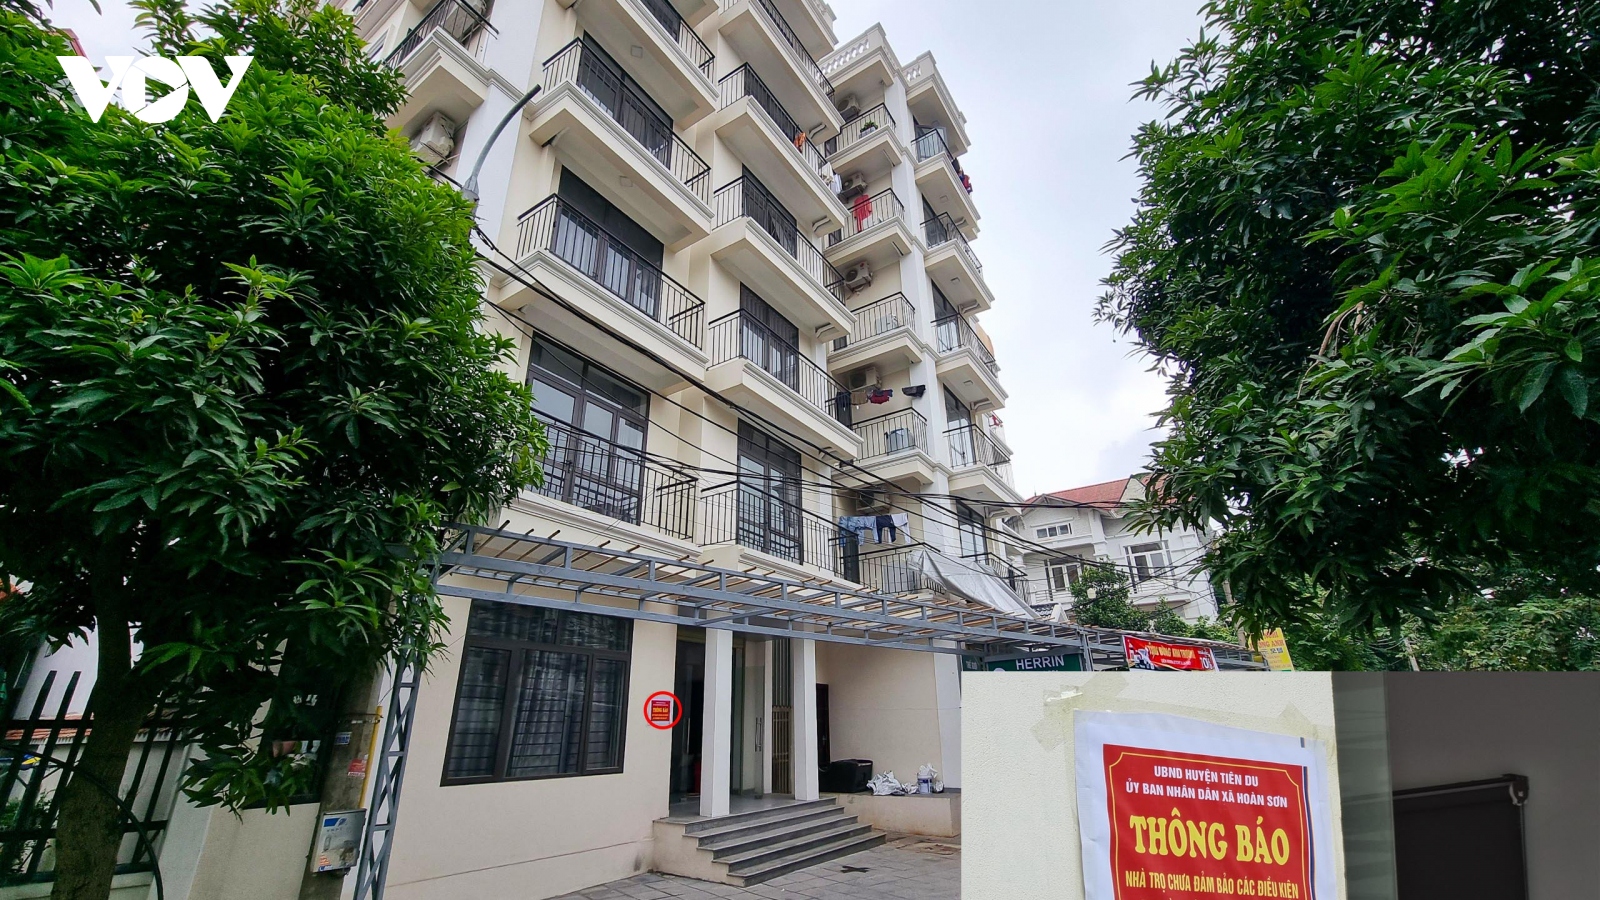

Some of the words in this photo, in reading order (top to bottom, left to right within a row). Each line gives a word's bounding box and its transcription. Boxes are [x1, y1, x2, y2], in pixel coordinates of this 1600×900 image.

[1015, 654, 1065, 670] HERRIN
[1154, 765, 1182, 779] UBND
[1185, 768, 1218, 784] HUYỆN
[1220, 772, 1242, 785] TIÊN
[1245, 775, 1259, 787] DU
[1126, 778, 1140, 793] ỦY
[1142, 784, 1164, 796] BAN
[1166, 784, 1195, 799] NHÂN
[1198, 787, 1219, 801] DÂN
[1221, 789, 1235, 803] XÃ
[1237, 791, 1265, 806] HOÀN
[1267, 795, 1288, 808] SƠN
[1129, 807, 1228, 861] THÔNG
[1235, 815, 1290, 866] BÁO
[1125, 868, 1146, 888] NHÀ
[1149, 872, 1166, 893] TRỌ
[1167, 873, 1192, 892] CHƯA
[1193, 870, 1215, 893] ĐẢM
[1216, 872, 1235, 895] BẢO
[1236, 875, 1255, 896] CÁC
[1257, 876, 1279, 898] ĐIỀU
